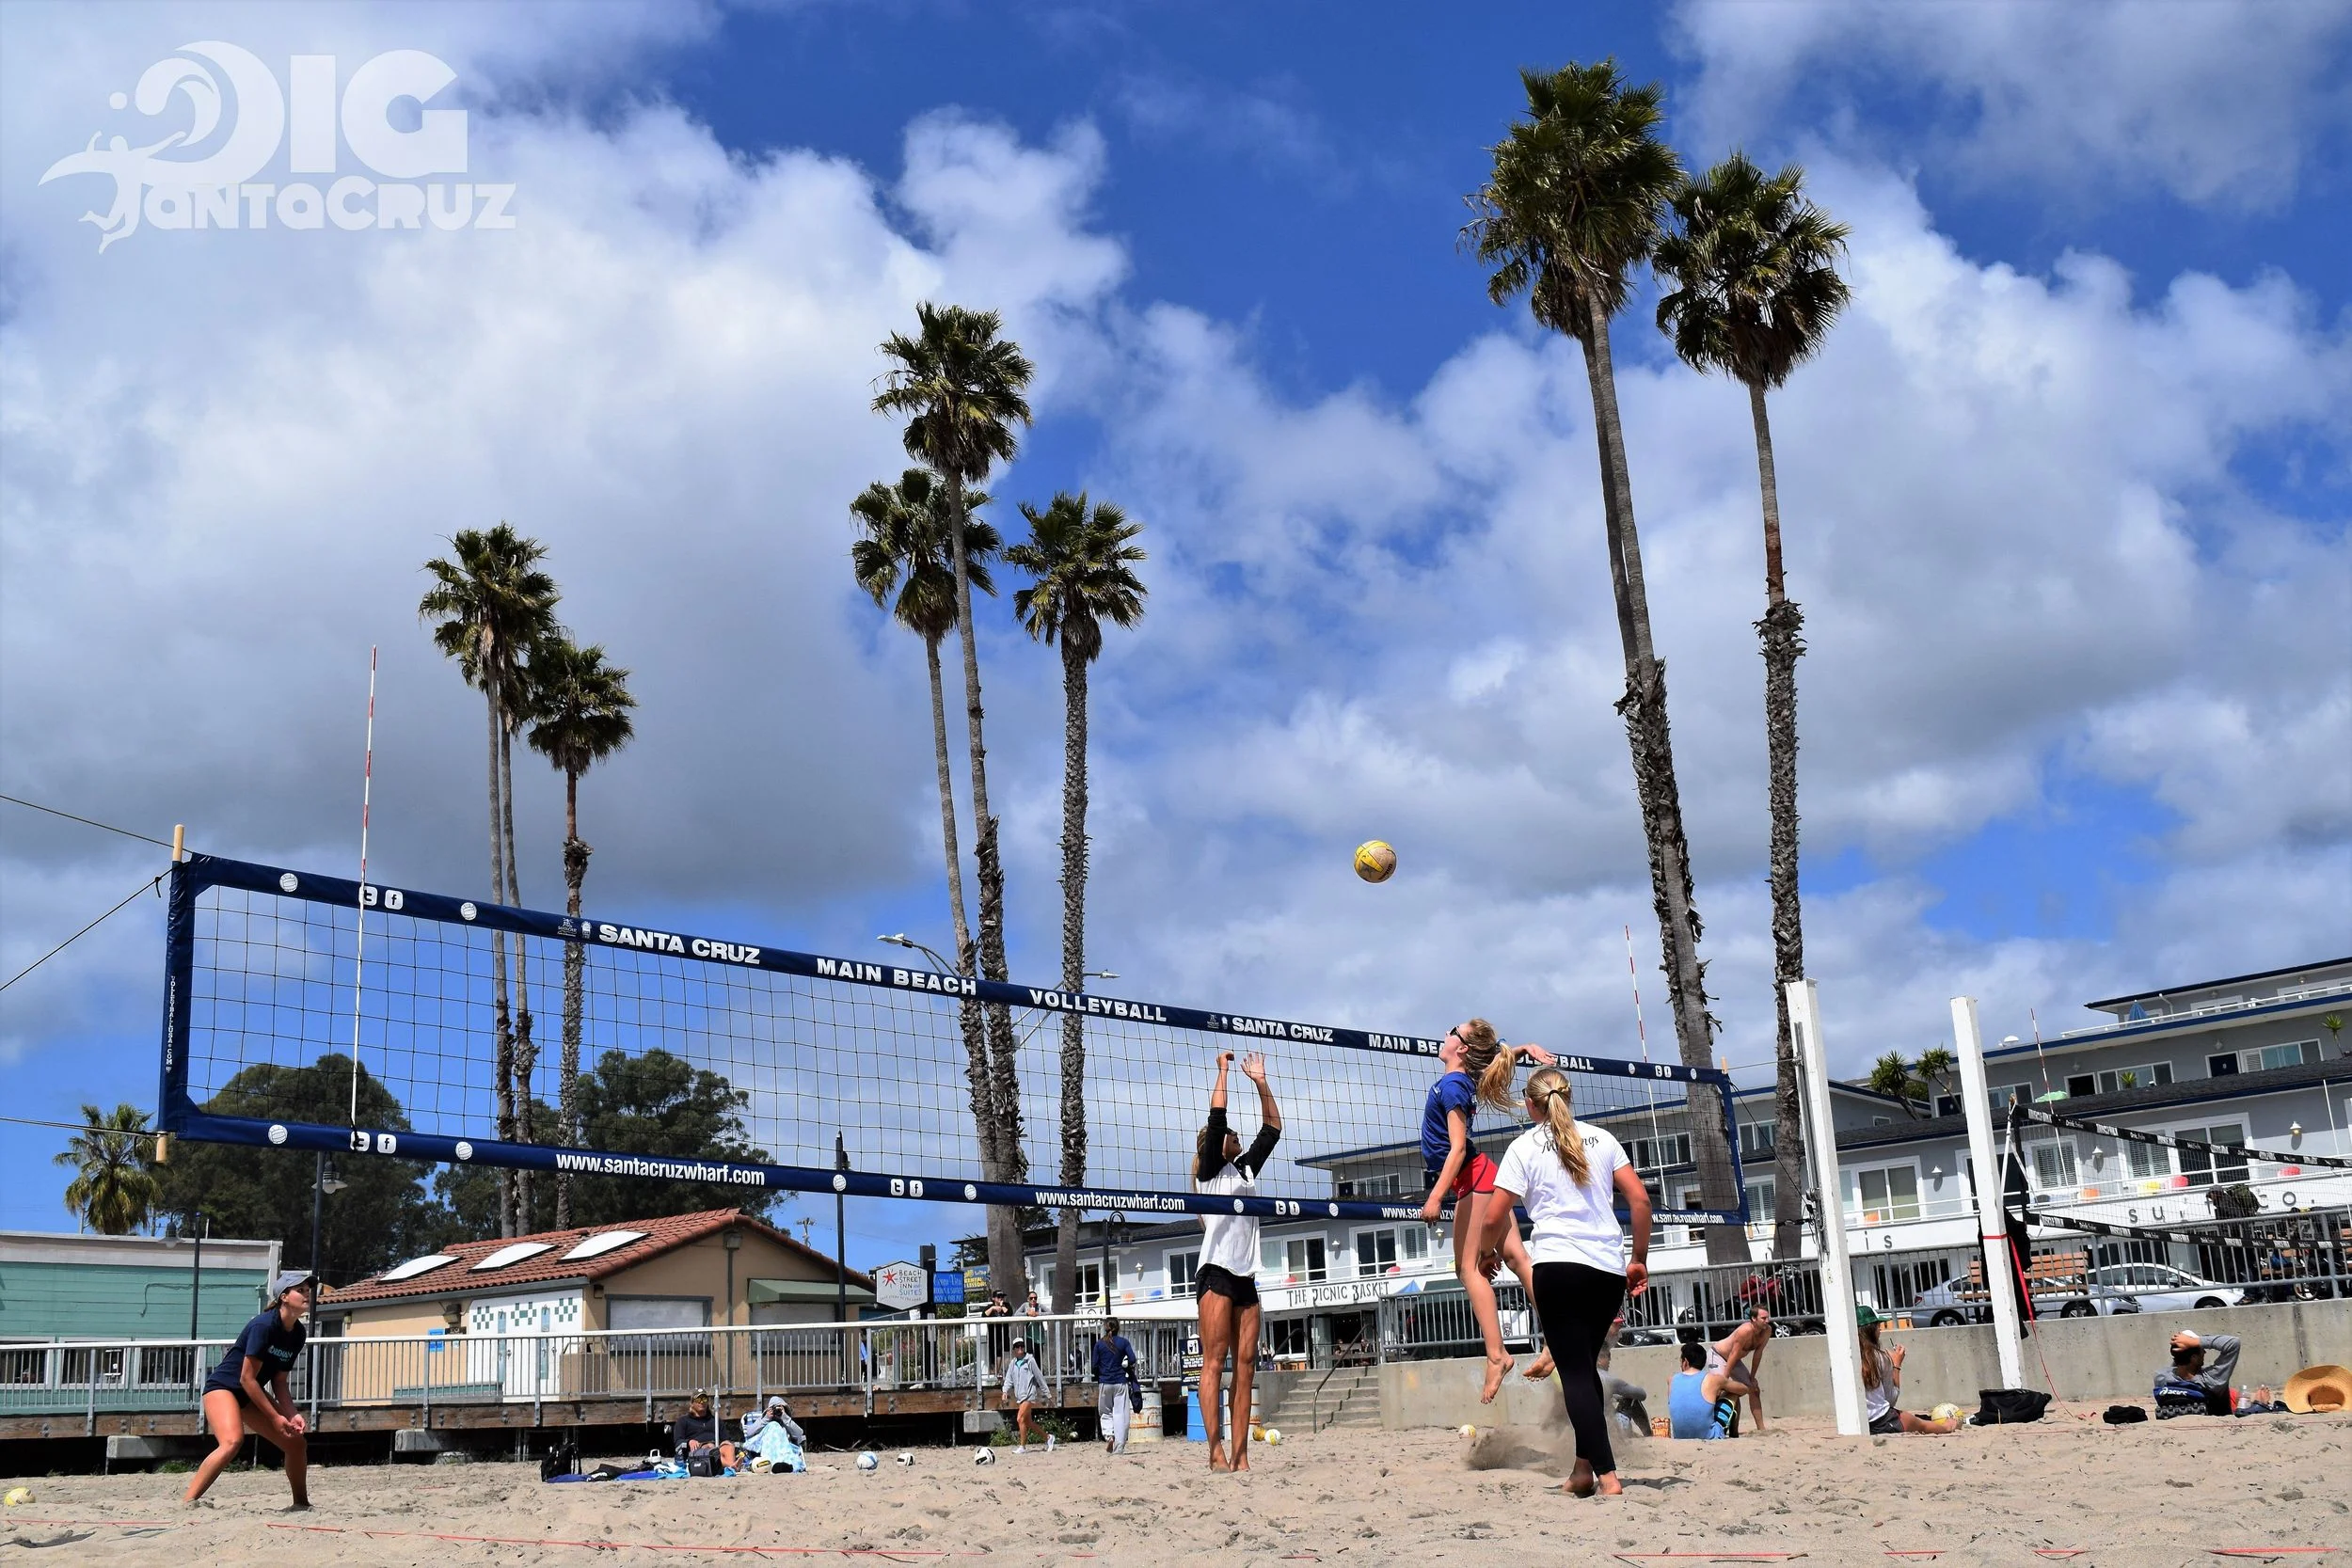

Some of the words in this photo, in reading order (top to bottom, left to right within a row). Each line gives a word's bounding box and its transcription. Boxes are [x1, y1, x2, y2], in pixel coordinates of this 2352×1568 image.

[598, 924, 686, 954] SANTA
[691, 939, 760, 965] CRUZ
[817, 958, 882, 984] MAIN
[893, 967, 977, 996] BEACH
[1029, 989, 1167, 1022] VOLLEYBALL
[1232, 1017, 1287, 1037] SANTA
[1290, 1024, 1334, 1043] CRUZ
[1368, 1034, 1411, 1052] MAIN
[556, 1153, 766, 1187] www.santacruzwharf.com
[1036, 1191, 1185, 1212] www.santacruzwharf.com
[1651, 1212, 1725, 1224] w.santacruzwharf.com
[1287, 1290, 1307, 1307] THE
[1312, 1285, 1348, 1306] PICNIC
[1352, 1281, 1390, 1301] BASKET
